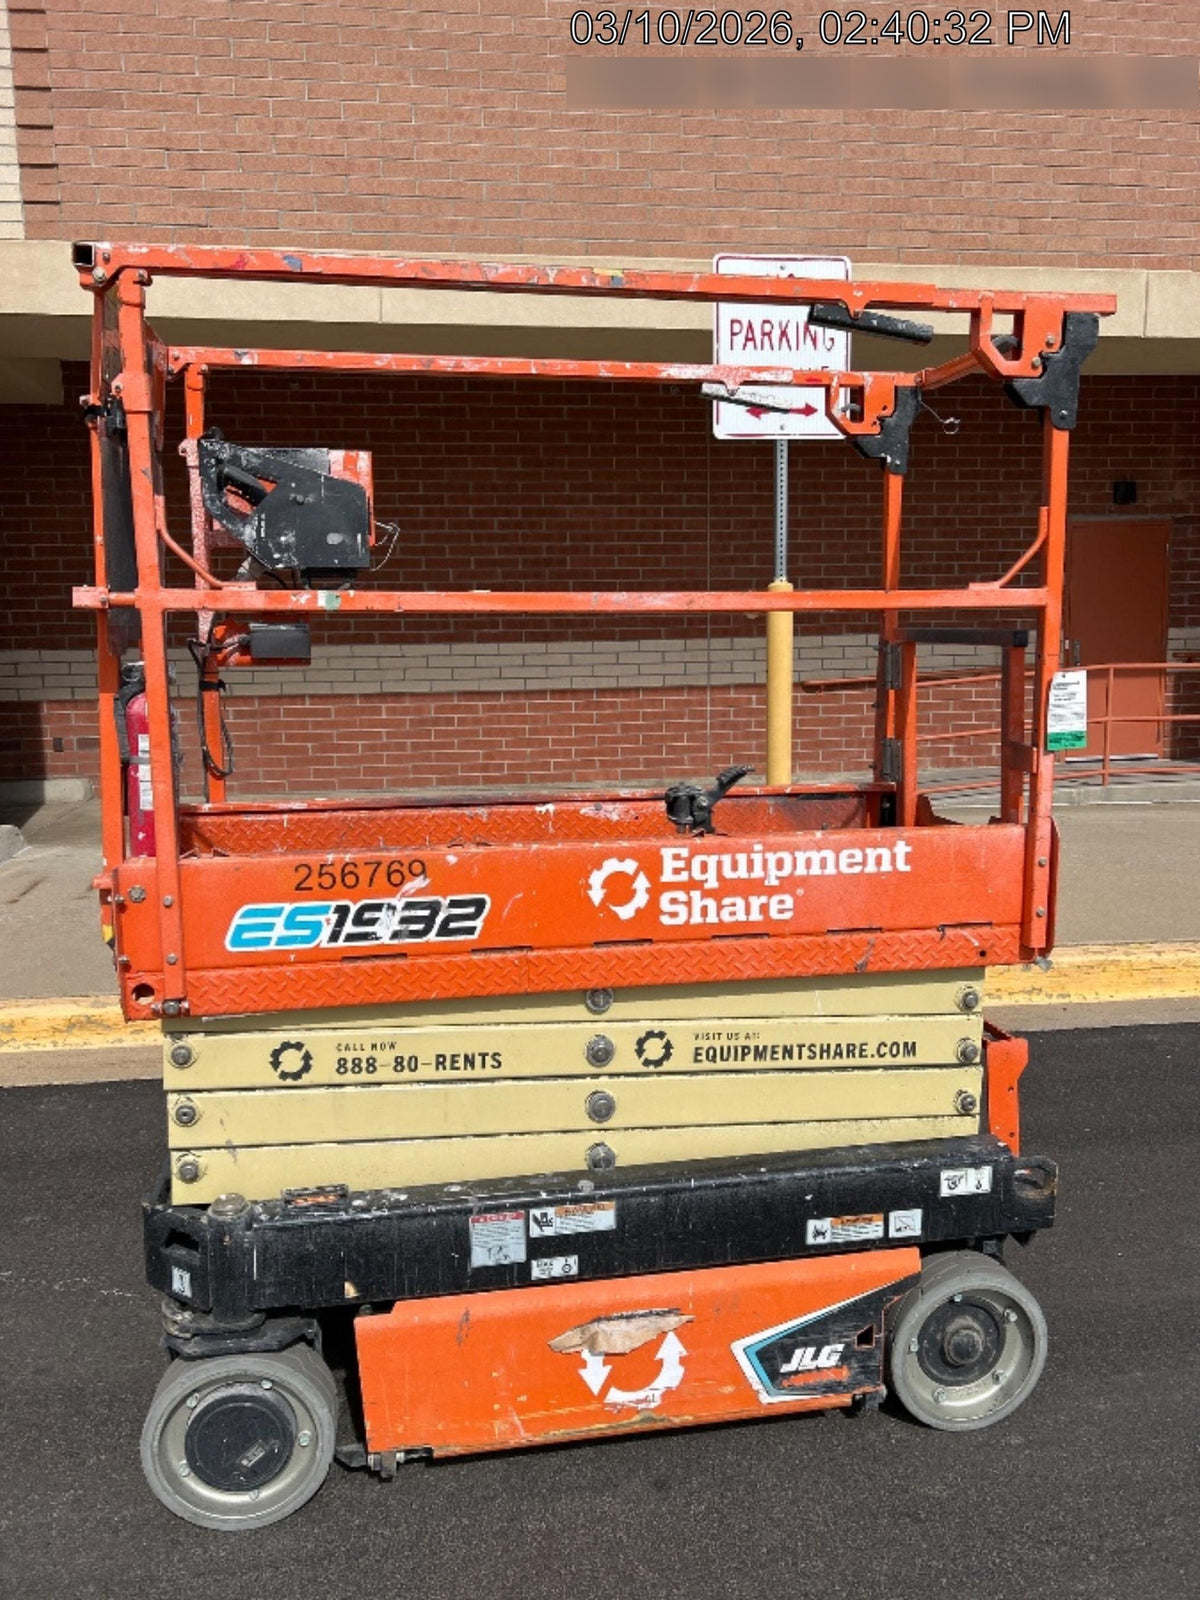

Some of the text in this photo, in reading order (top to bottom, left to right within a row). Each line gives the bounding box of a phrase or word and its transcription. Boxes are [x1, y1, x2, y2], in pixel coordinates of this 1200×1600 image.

[730, 319, 835, 352] PARKING
[294, 859, 427, 892] 256769
[660, 840, 912, 889] Equipment
[226, 896, 489, 950] ES1932
[336, 1041, 398, 1052] CALL NOW
[694, 1032, 722, 1041] VISIT
[726, 1032, 741, 1041] US
[335, 1052, 502, 1075] 888-80-RENTS
[693, 1041, 917, 1064] EQUIPMENTSHARE.COM
[779, 1344, 846, 1374] JLG
